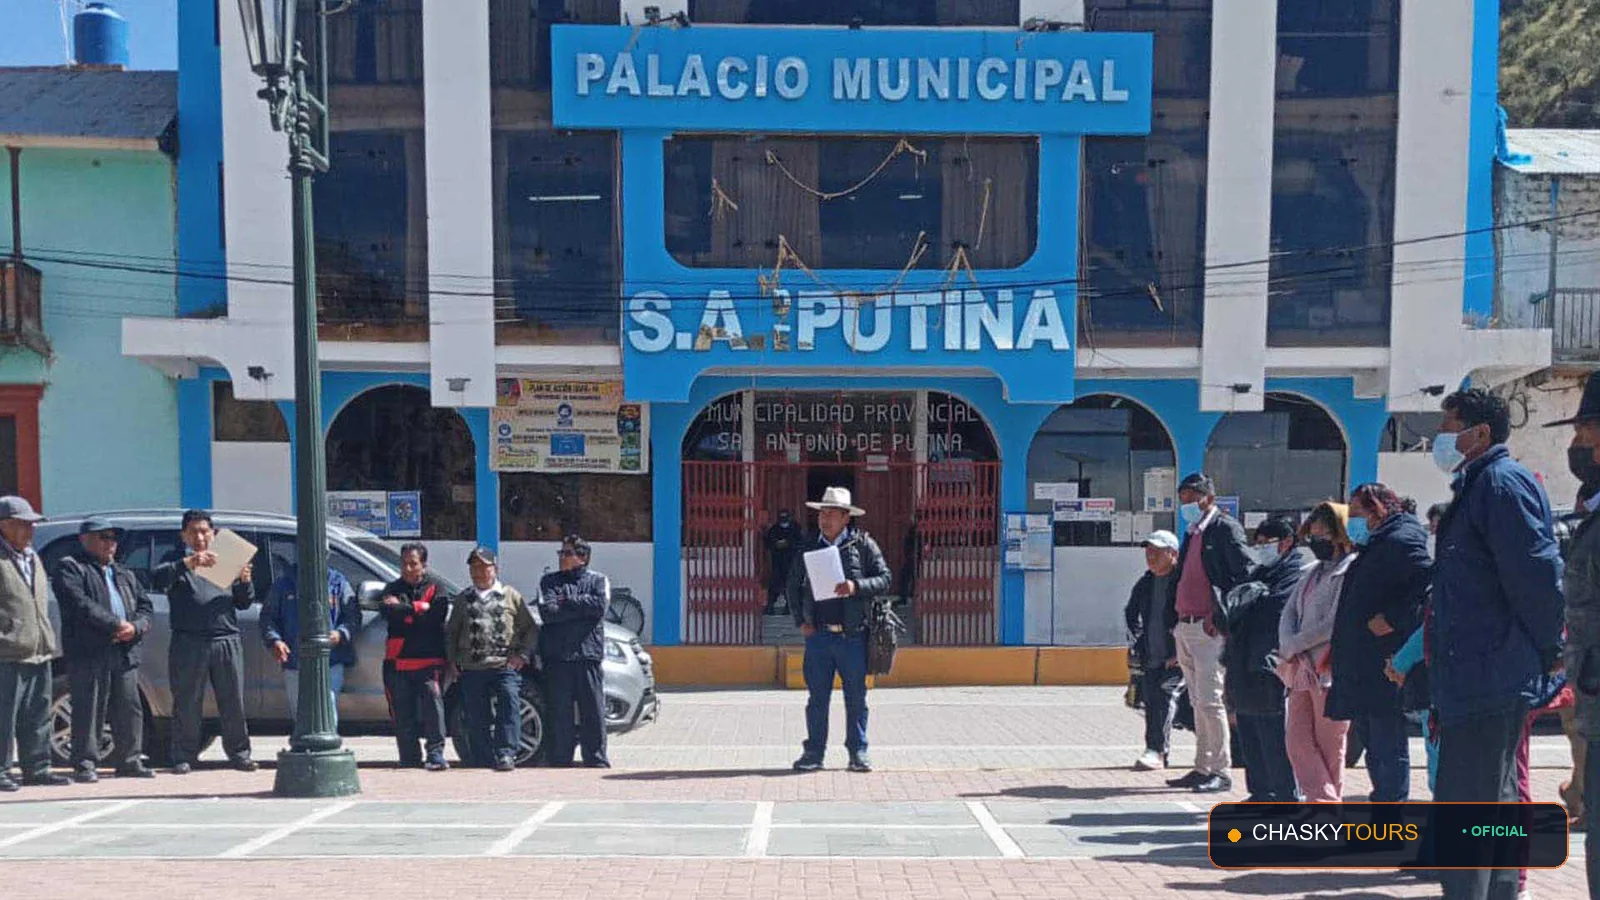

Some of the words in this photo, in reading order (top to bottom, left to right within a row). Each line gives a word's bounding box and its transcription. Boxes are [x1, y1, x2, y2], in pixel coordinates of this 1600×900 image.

[576, 52, 810, 100] PALACIO
[833, 57, 1129, 101] MUNICIPAL
[798, 289, 1070, 352] PUTINA
[707, 402, 854, 422] MUNCIPALIDAD
[864, 402, 979, 422] PROVNCIAL
[717, 432, 742, 451] SA
[857, 432, 883, 452] DE
